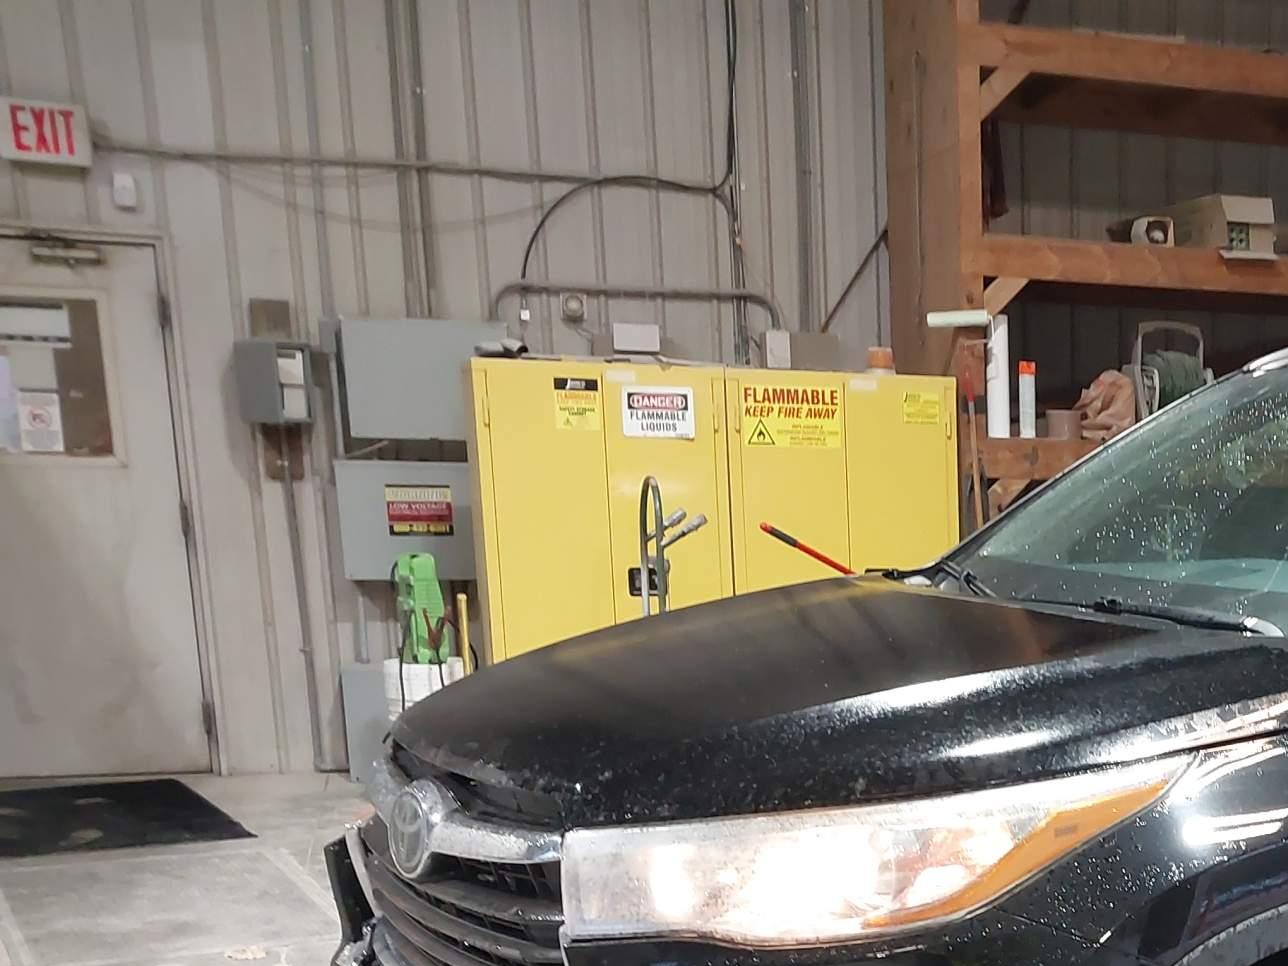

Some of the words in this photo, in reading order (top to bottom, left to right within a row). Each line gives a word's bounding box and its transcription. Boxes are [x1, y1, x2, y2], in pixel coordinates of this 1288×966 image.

[9, 104, 75, 156] EXIT
[634, 394, 682, 409] DANGER
[744, 386, 839, 406] FLAMMABLE
[630, 411, 687, 421] FLAMMABLE
[744, 405, 774, 417] KEEP
[777, 406, 802, 418] FIRE
[805, 407, 838, 420] AWAY
[641, 422, 677, 431] LIQUIDS
